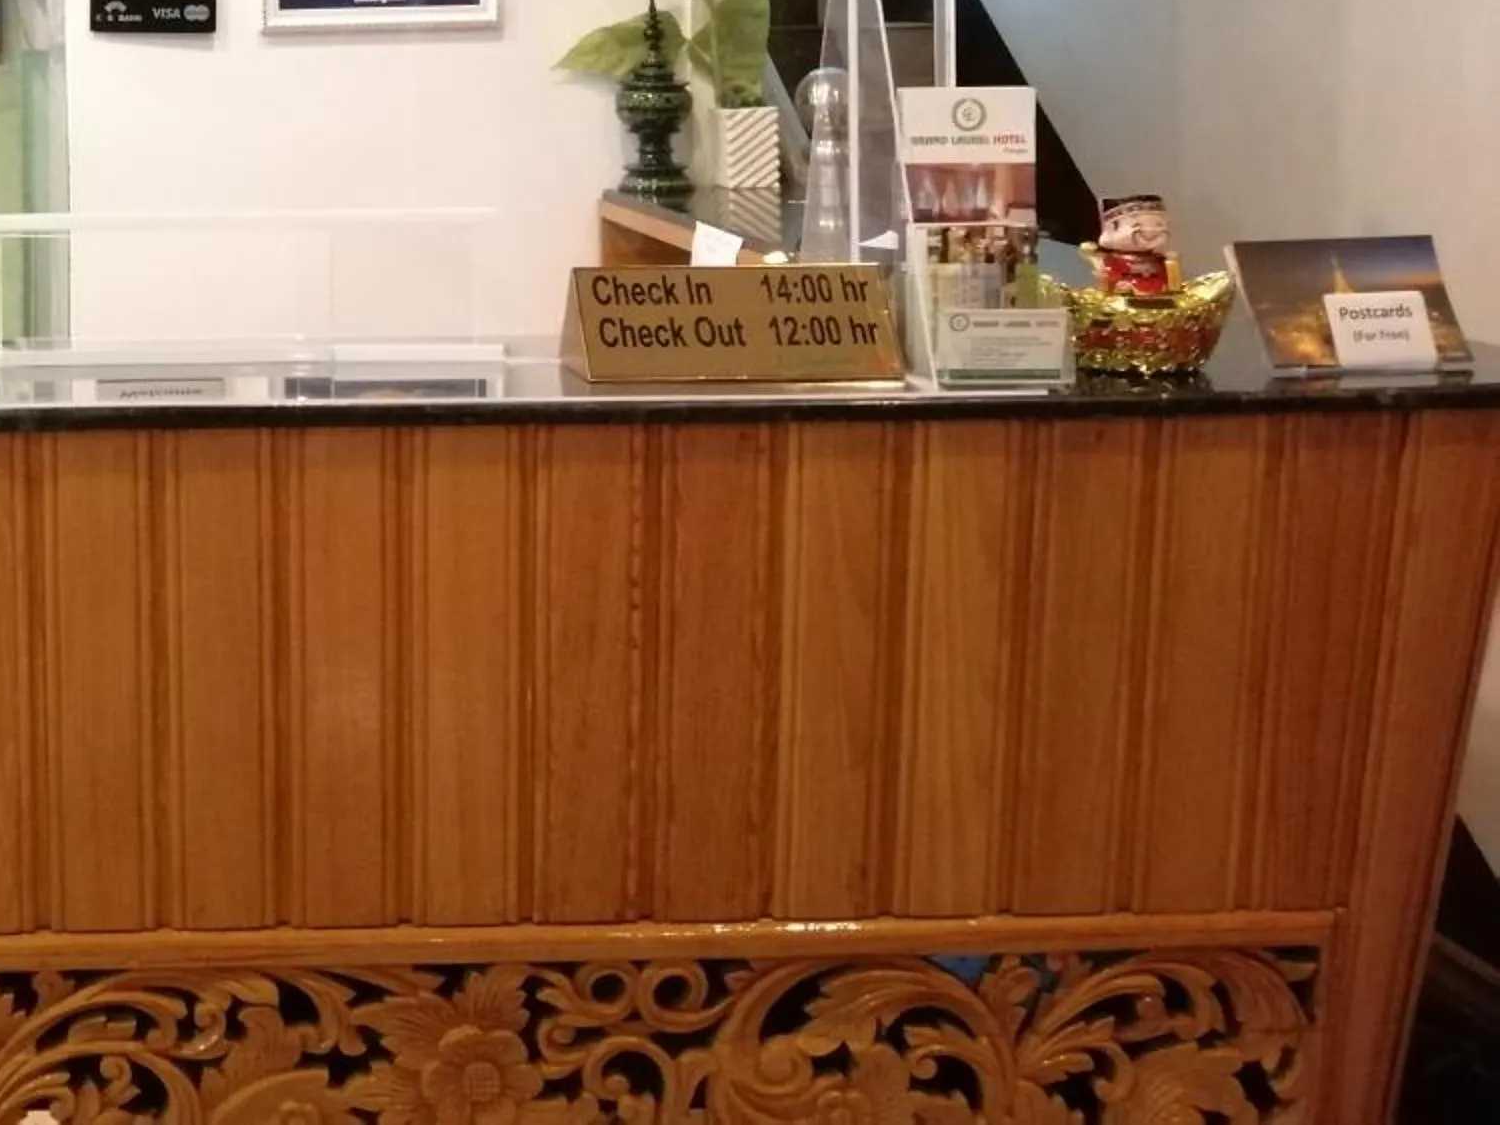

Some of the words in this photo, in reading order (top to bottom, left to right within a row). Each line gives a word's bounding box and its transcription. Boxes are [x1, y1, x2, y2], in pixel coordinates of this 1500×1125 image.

[152, 7, 181, 20] VISA
[993, 133, 1027, 145] HOTEL
[591, 275, 680, 305] Check
[686, 275, 713, 305] In
[760, 273, 833, 304] 14:00
[840, 273, 869, 303] hr
[1338, 302, 1413, 321] Postcards
[599, 317, 689, 348] Check
[694, 317, 747, 348] Out
[769, 315, 842, 346] 12:00
[850, 315, 878, 345] hr
